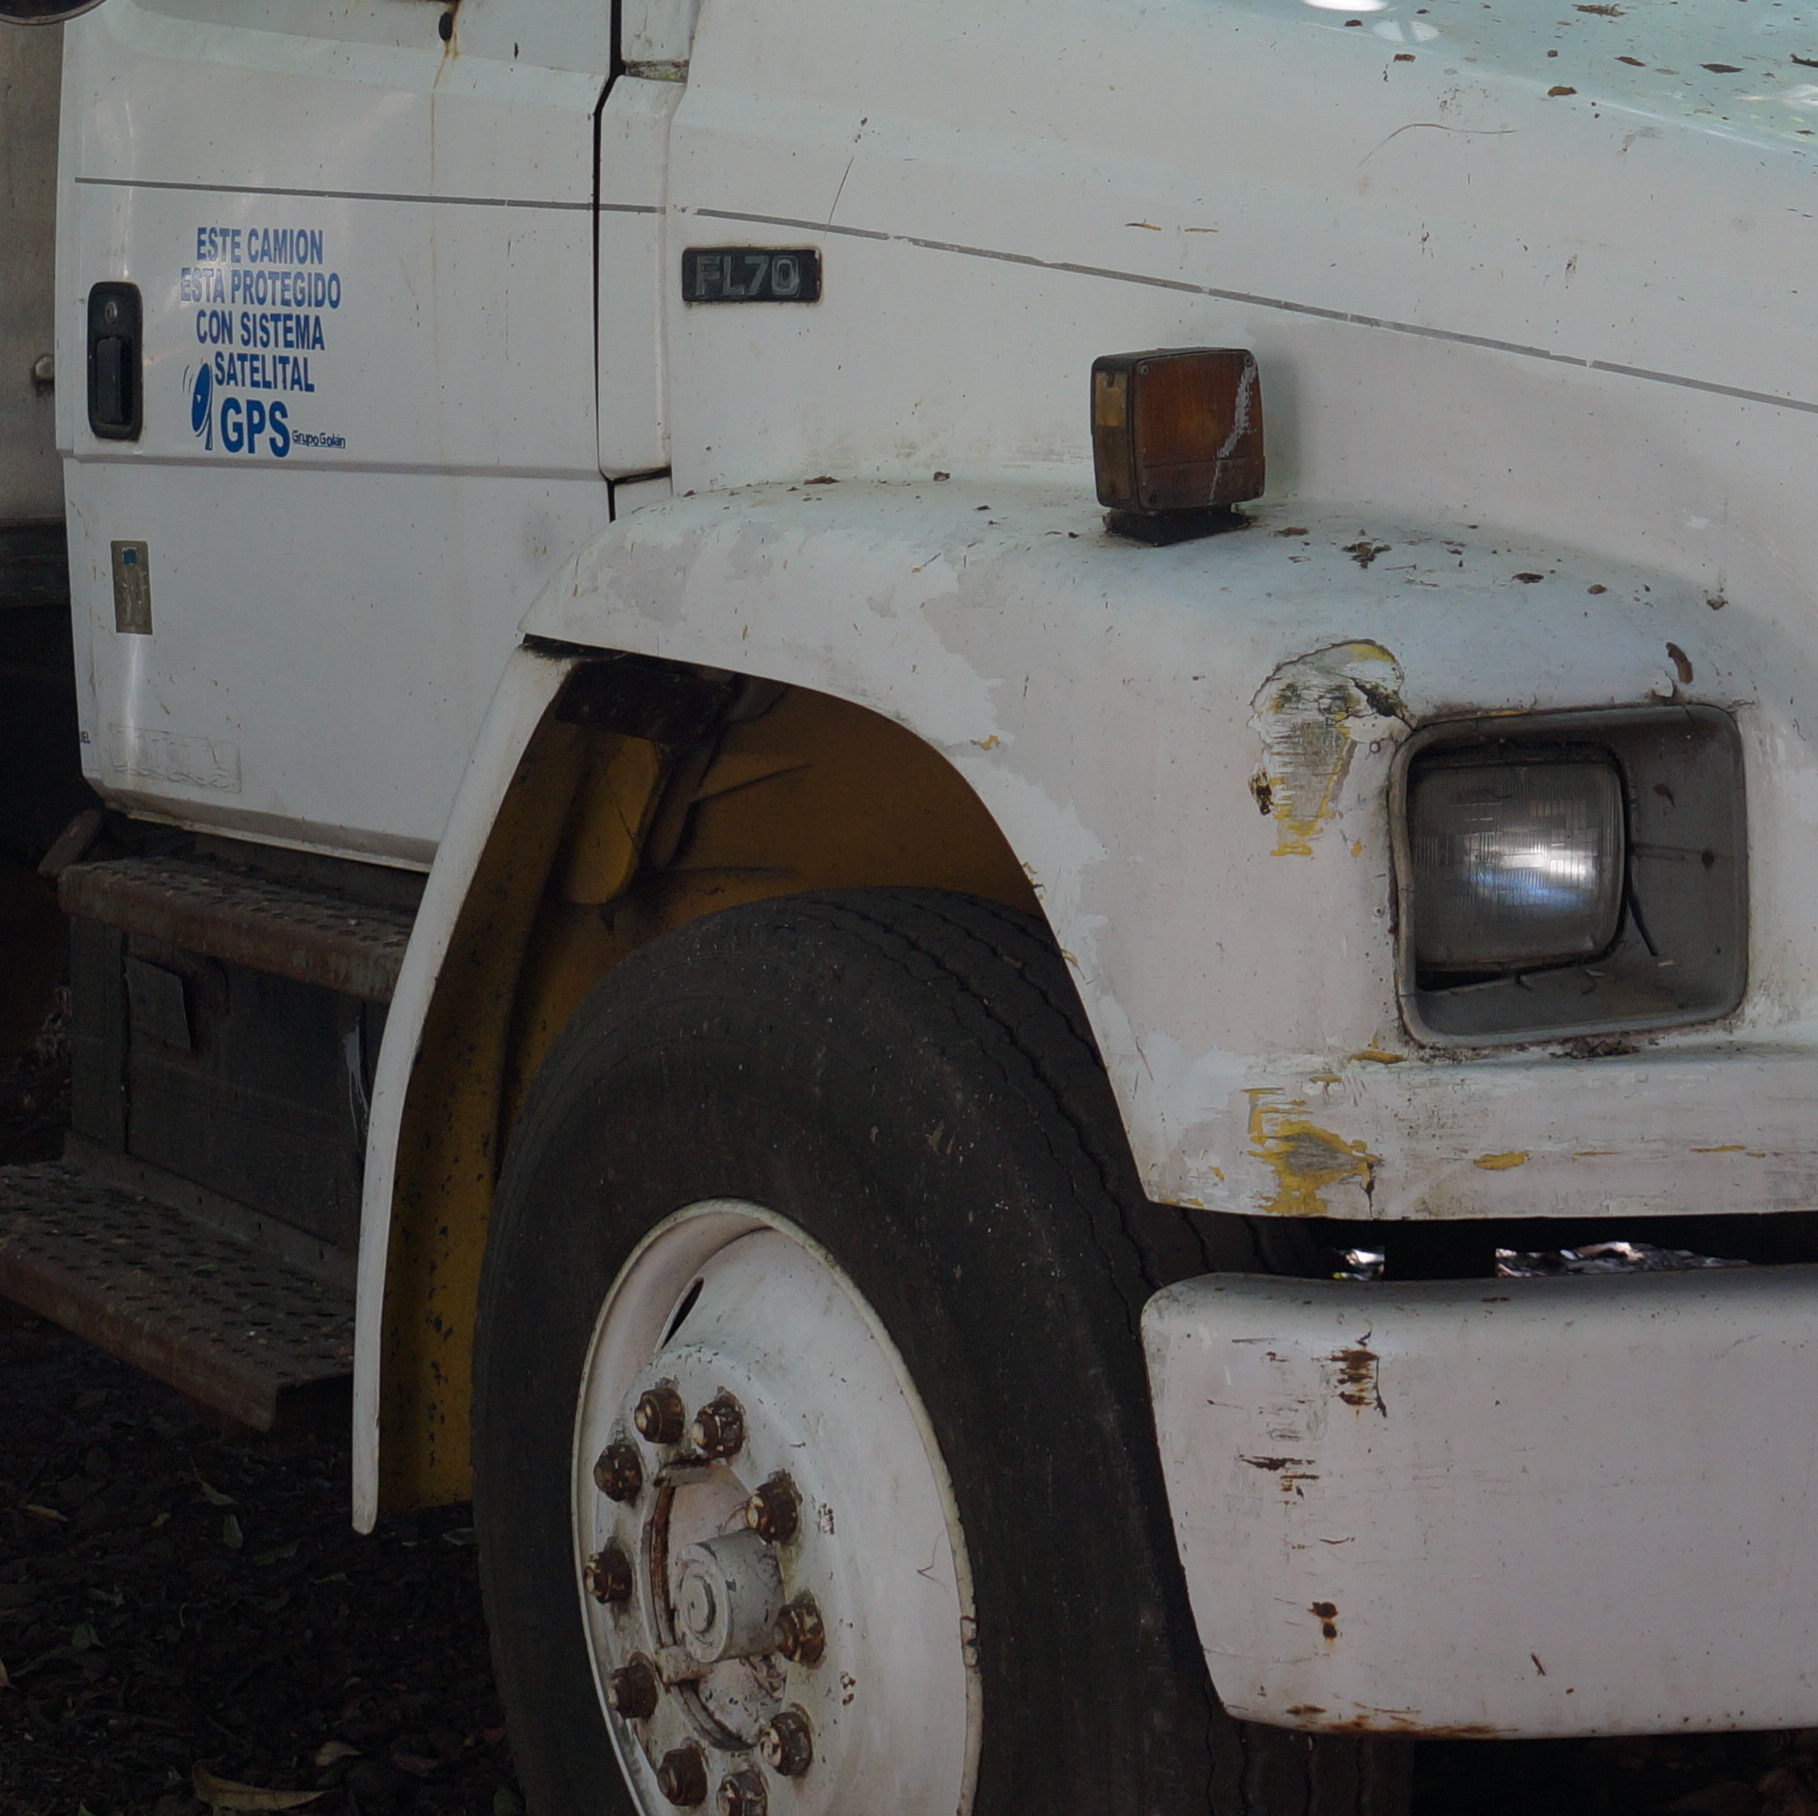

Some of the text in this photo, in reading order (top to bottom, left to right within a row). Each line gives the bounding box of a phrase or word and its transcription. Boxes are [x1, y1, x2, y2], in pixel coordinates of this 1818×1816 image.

[197, 227, 324, 265] ESTE CAMION
[180, 267, 342, 309] ESTA PROTEGIDO
[695, 254, 800, 298] FL70
[196, 309, 325, 351] CON SISTEMA
[214, 351, 315, 393] SATELITAL
[220, 397, 291, 458] GPS
